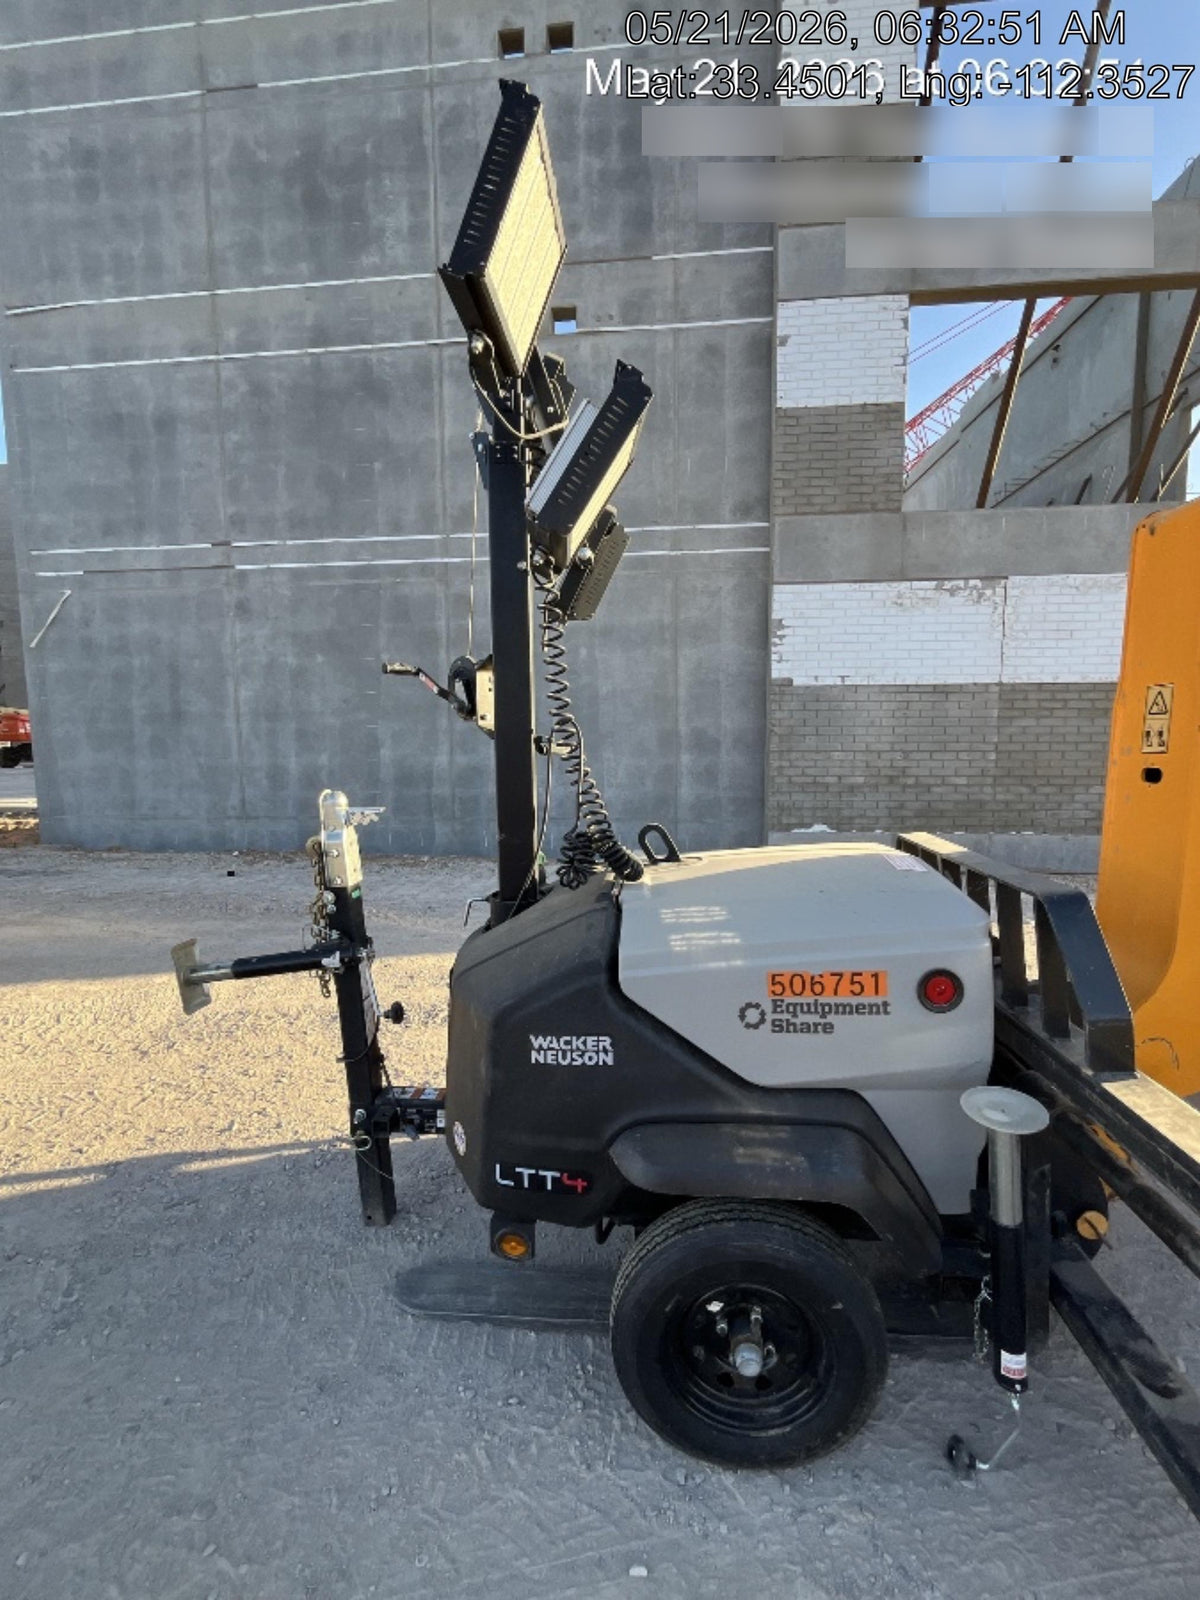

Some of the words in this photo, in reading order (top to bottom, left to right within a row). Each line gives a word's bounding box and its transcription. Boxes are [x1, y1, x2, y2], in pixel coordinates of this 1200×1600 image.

[770, 971, 883, 997] 506751
[771, 999, 891, 1018] Equipment
[771, 1018, 835, 1034] Share
[529, 1034, 614, 1051] WACKER
[530, 1050, 615, 1066] NEUSON
[495, 1163, 588, 1194] LTT4
